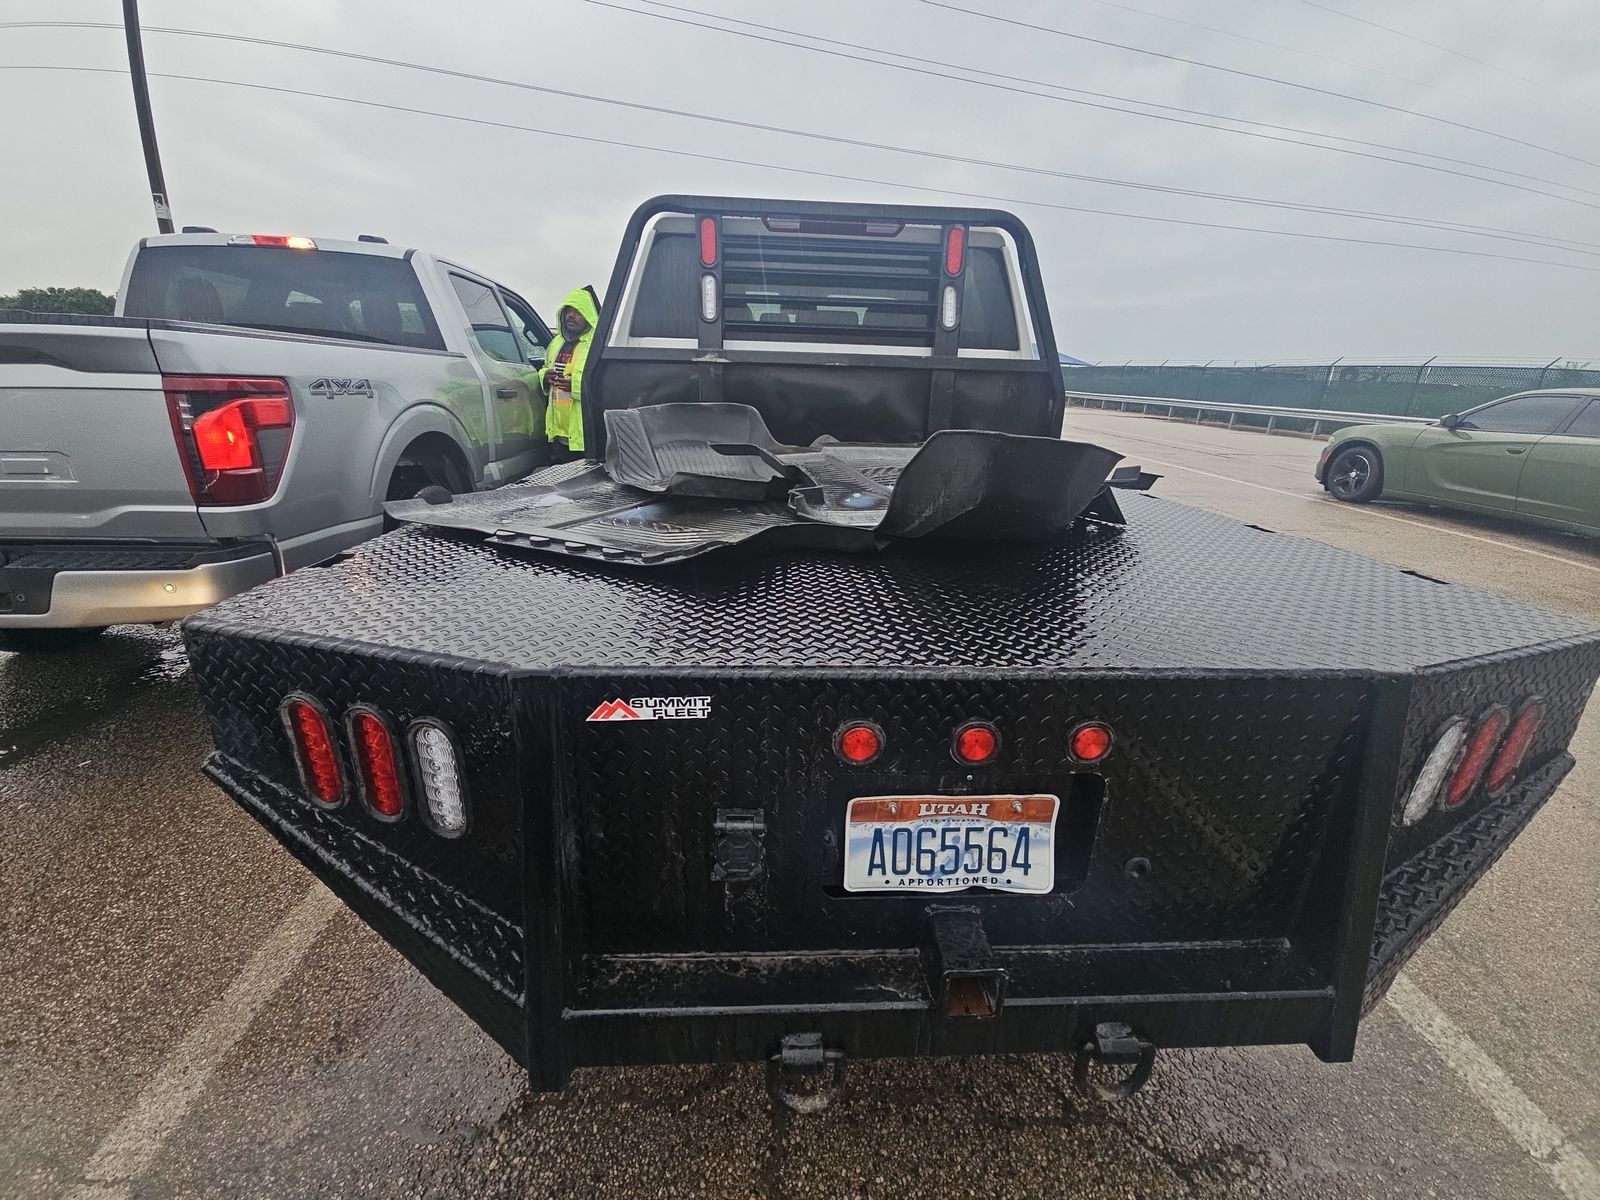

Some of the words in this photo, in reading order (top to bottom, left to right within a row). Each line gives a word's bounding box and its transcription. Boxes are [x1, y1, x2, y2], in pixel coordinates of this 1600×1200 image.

[631, 697, 709, 708] SUMMIT
[652, 708, 709, 718] FLEET
[917, 803, 990, 817] UTAH
[867, 826, 1032, 876] A065564
[898, 876, 999, 887] APPORTIONED
